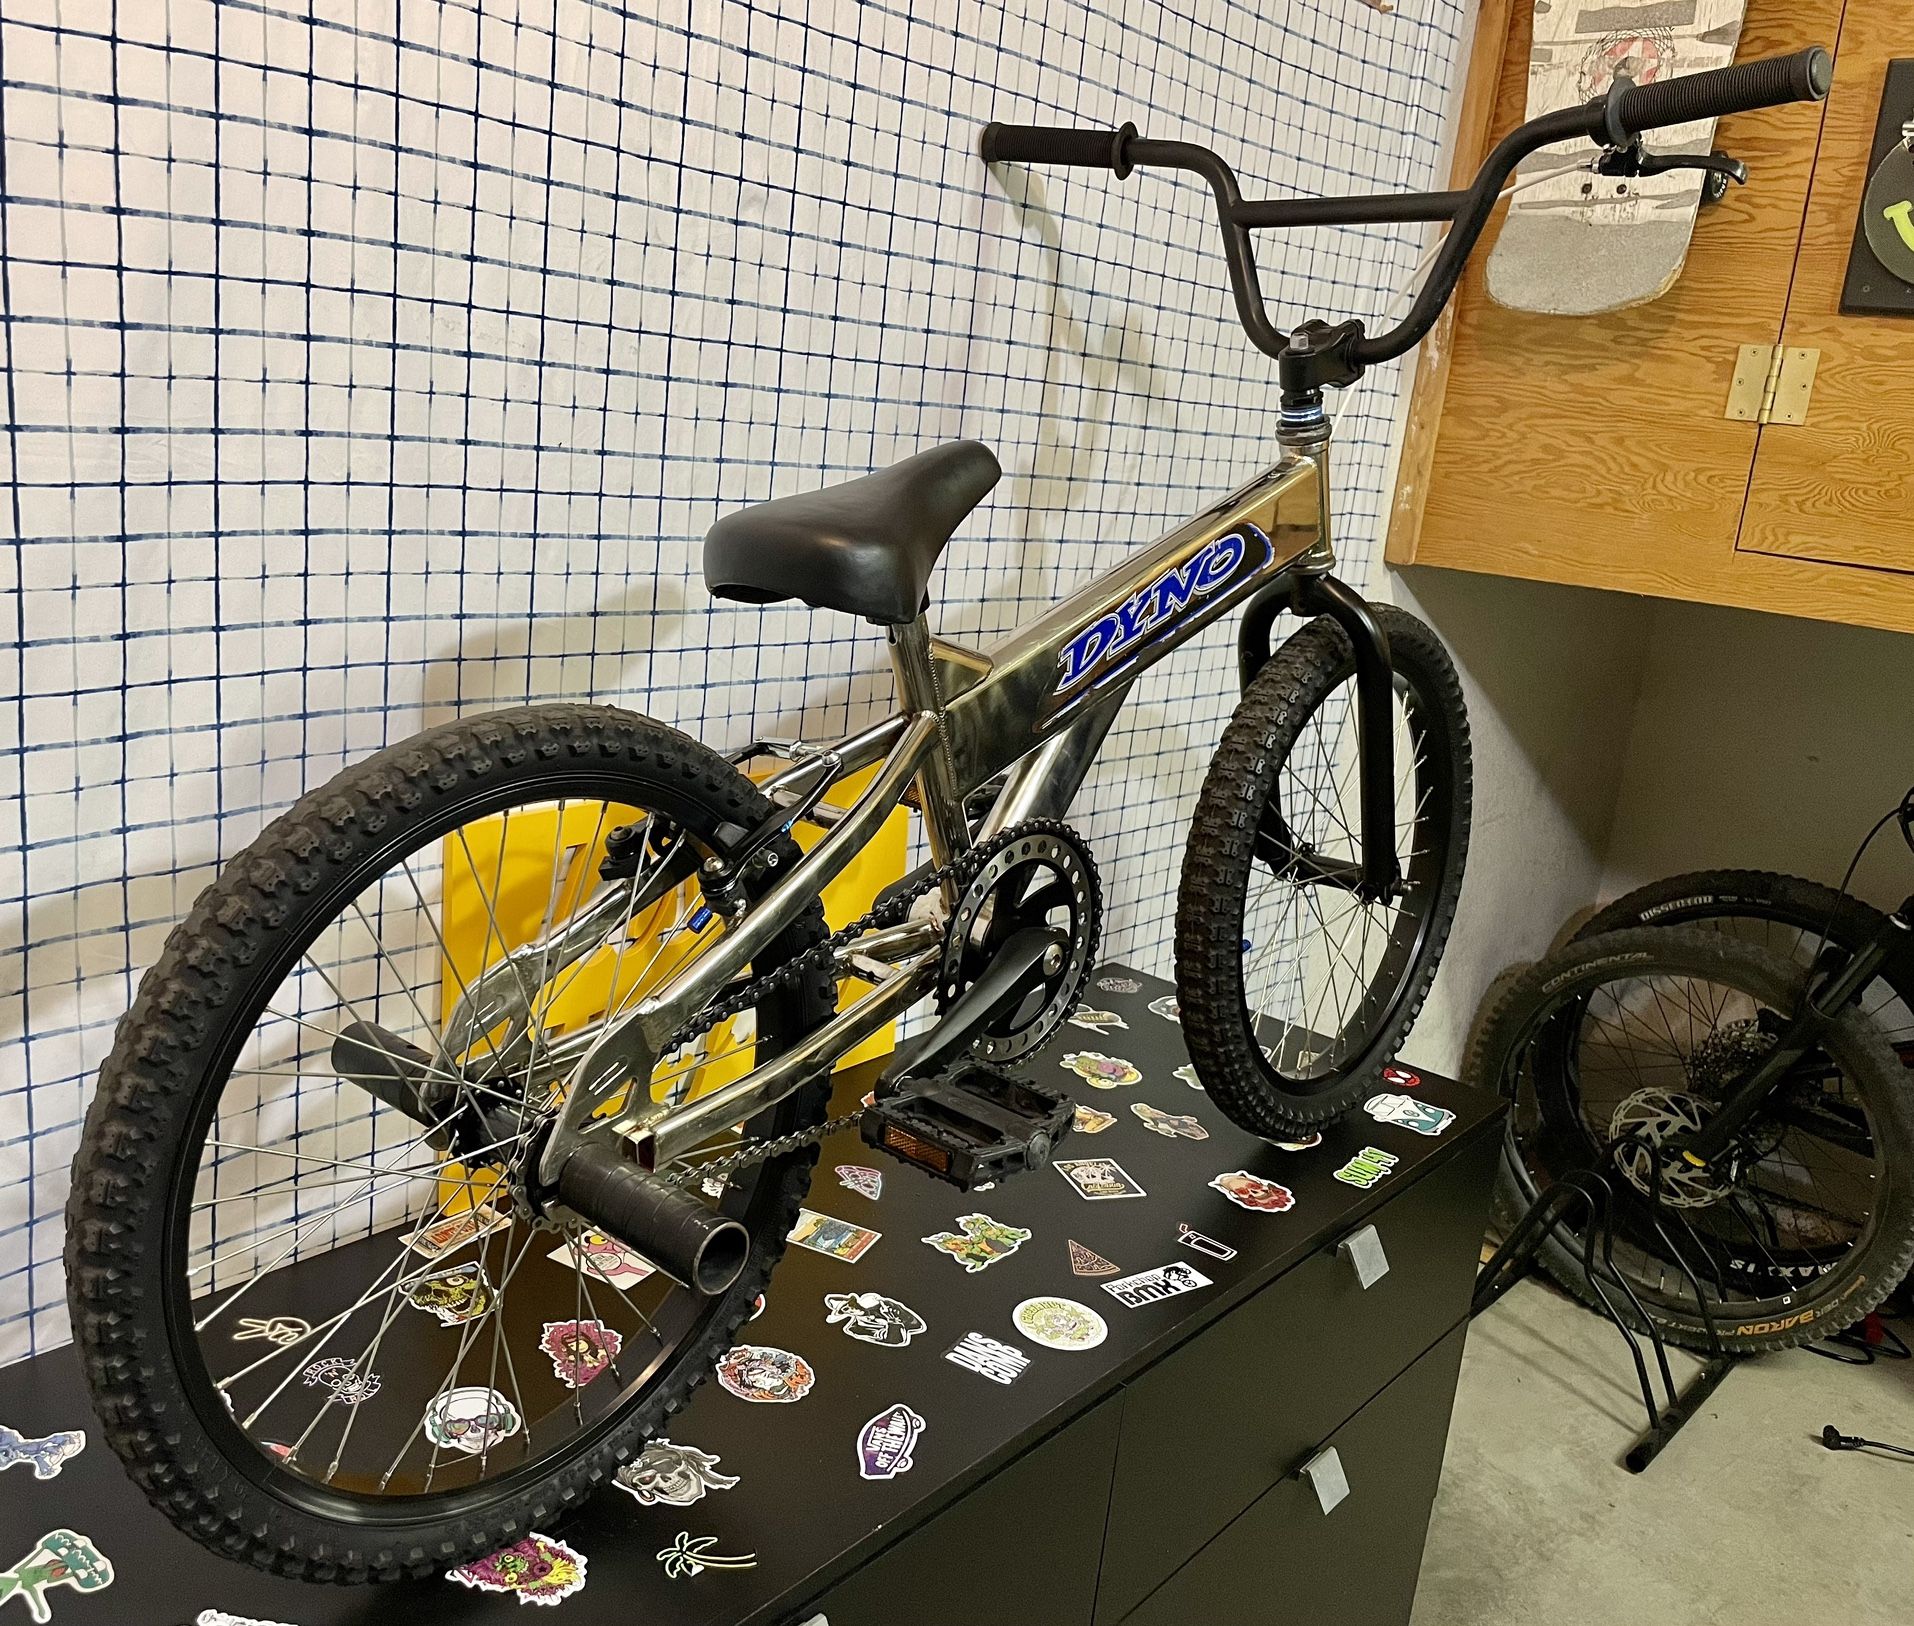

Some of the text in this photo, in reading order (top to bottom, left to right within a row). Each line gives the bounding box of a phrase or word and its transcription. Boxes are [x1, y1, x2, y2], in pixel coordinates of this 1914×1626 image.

[1053, 534, 1245, 695] DYNO
[1542, 952, 1654, 994] CONTINENTAL
[1336, 1158, 1389, 1186] SUM
[1105, 1273, 1161, 1292] Porkchop
[1116, 1279, 1181, 1305] BMX
[1667, 1321, 1735, 1336] PRJEKT
[1736, 1309, 1816, 1336] BARON
[945, 1332, 1003, 1373] DANS
[979, 1345, 1031, 1385] COMP
[306, 1358, 339, 1374] ROCK
[866, 1426, 887, 1450] VANS
[881, 1432, 904, 1452] THE
[875, 1452, 893, 1468] OFF
